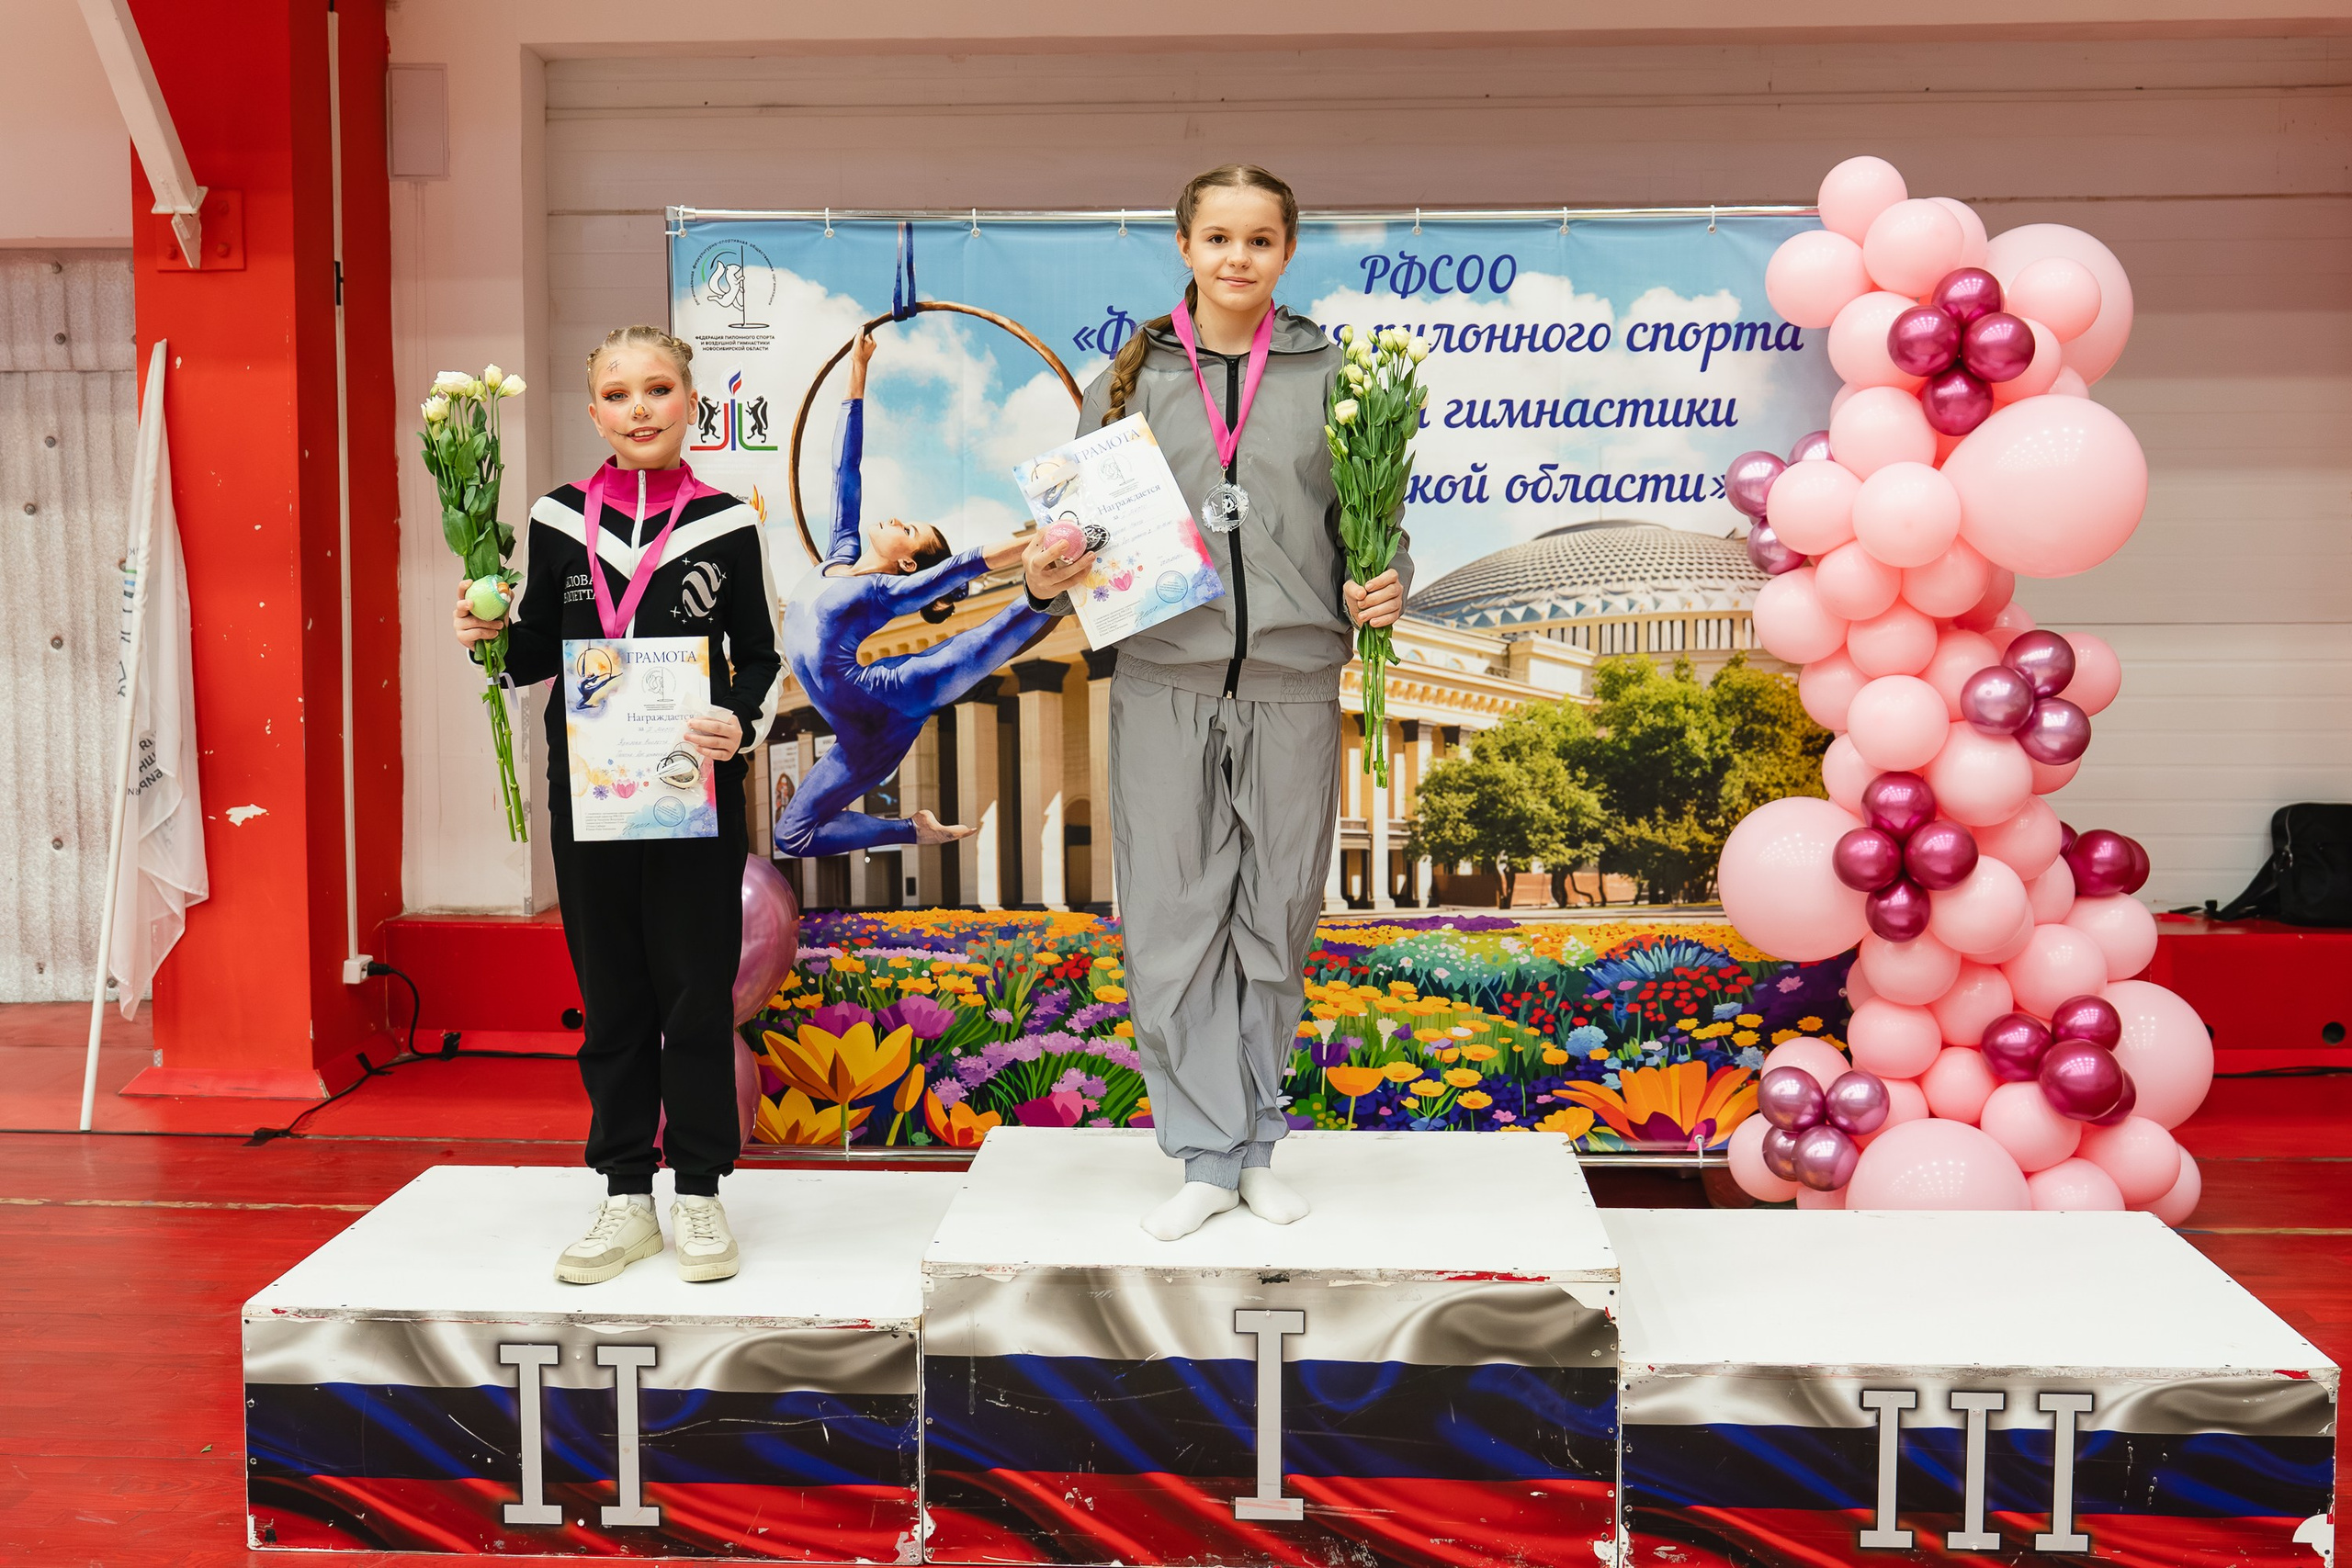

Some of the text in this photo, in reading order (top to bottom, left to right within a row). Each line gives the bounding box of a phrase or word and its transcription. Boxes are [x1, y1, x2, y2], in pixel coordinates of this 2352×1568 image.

[1360, 250, 1517, 299] РФСОО
[1626, 321, 1804, 372] спорта
[1443, 398, 1738, 428] гимнастики
[1074, 428, 1140, 464] ГРАМОТА
[1097, 484, 1161, 515] Награждается
[626, 650, 697, 663] ГРАМОТА
[627, 712, 695, 724] Награждается
[498, 1343, 662, 1528] II
[1235, 1309, 1305, 1521] I
[1859, 1389, 2095, 1553] III
